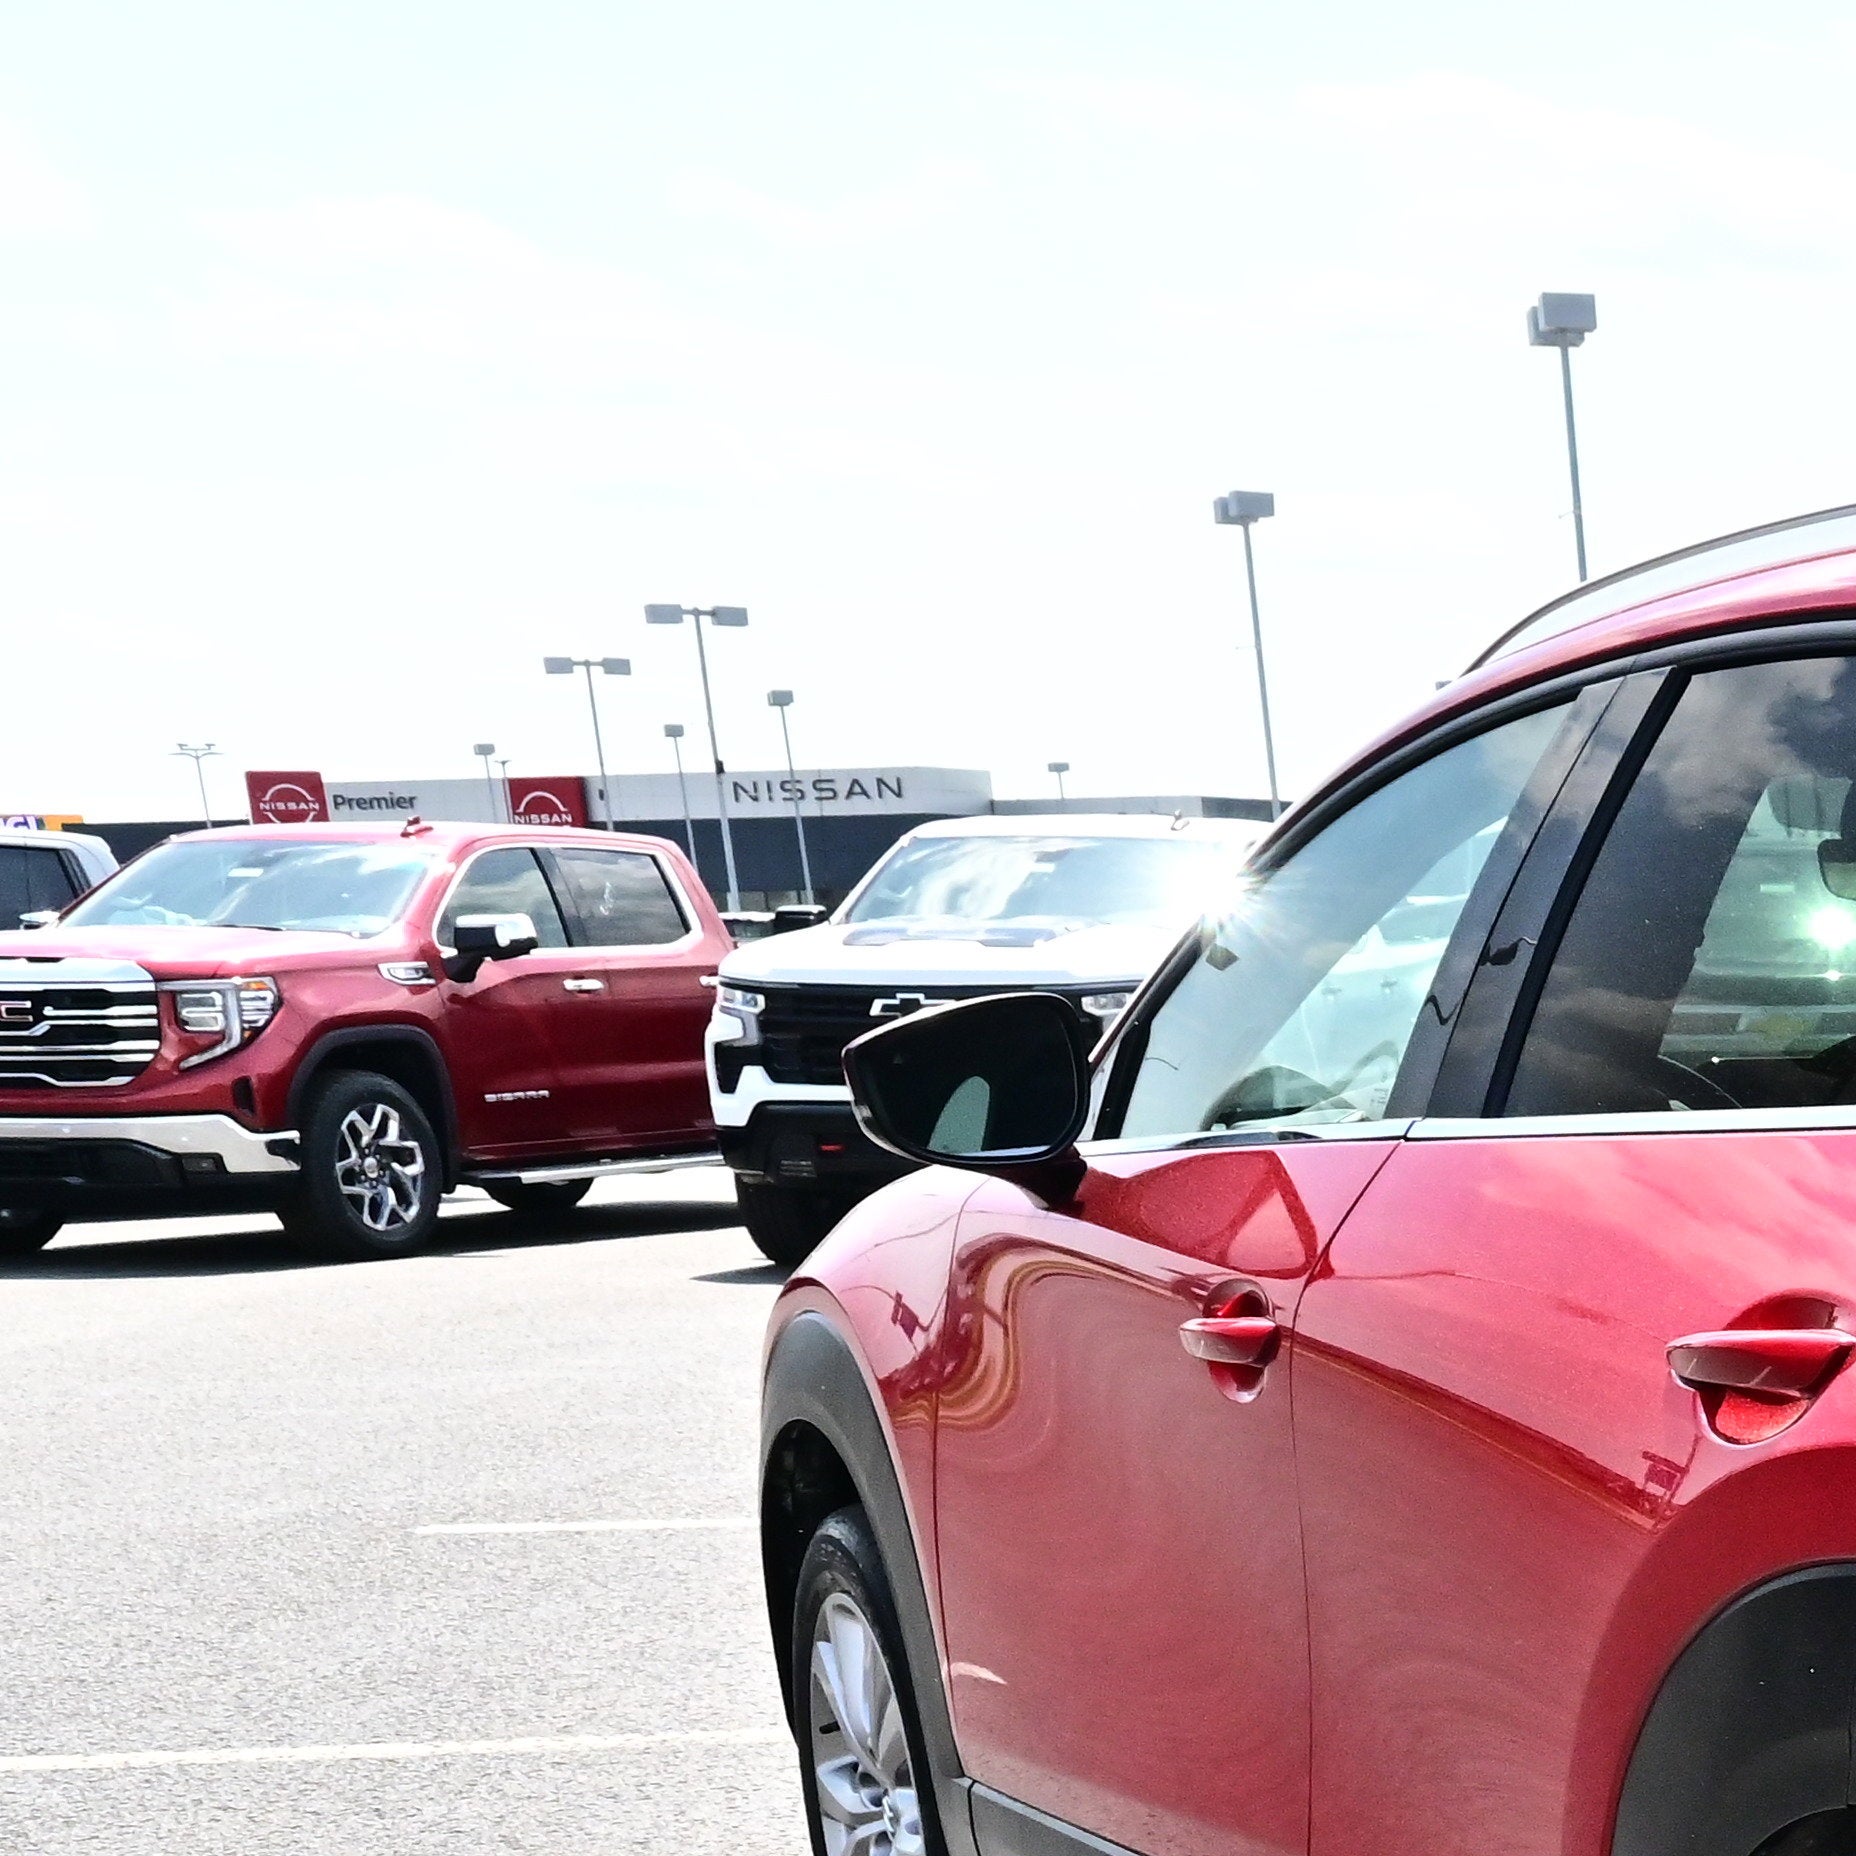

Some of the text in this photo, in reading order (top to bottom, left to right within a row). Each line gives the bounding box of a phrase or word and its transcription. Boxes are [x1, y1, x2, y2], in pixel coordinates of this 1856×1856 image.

[732, 776, 904, 804] NISSAN
[260, 802, 319, 811] NISSAN
[332, 791, 417, 810] Premier
[514, 813, 573, 824] NISSAN
